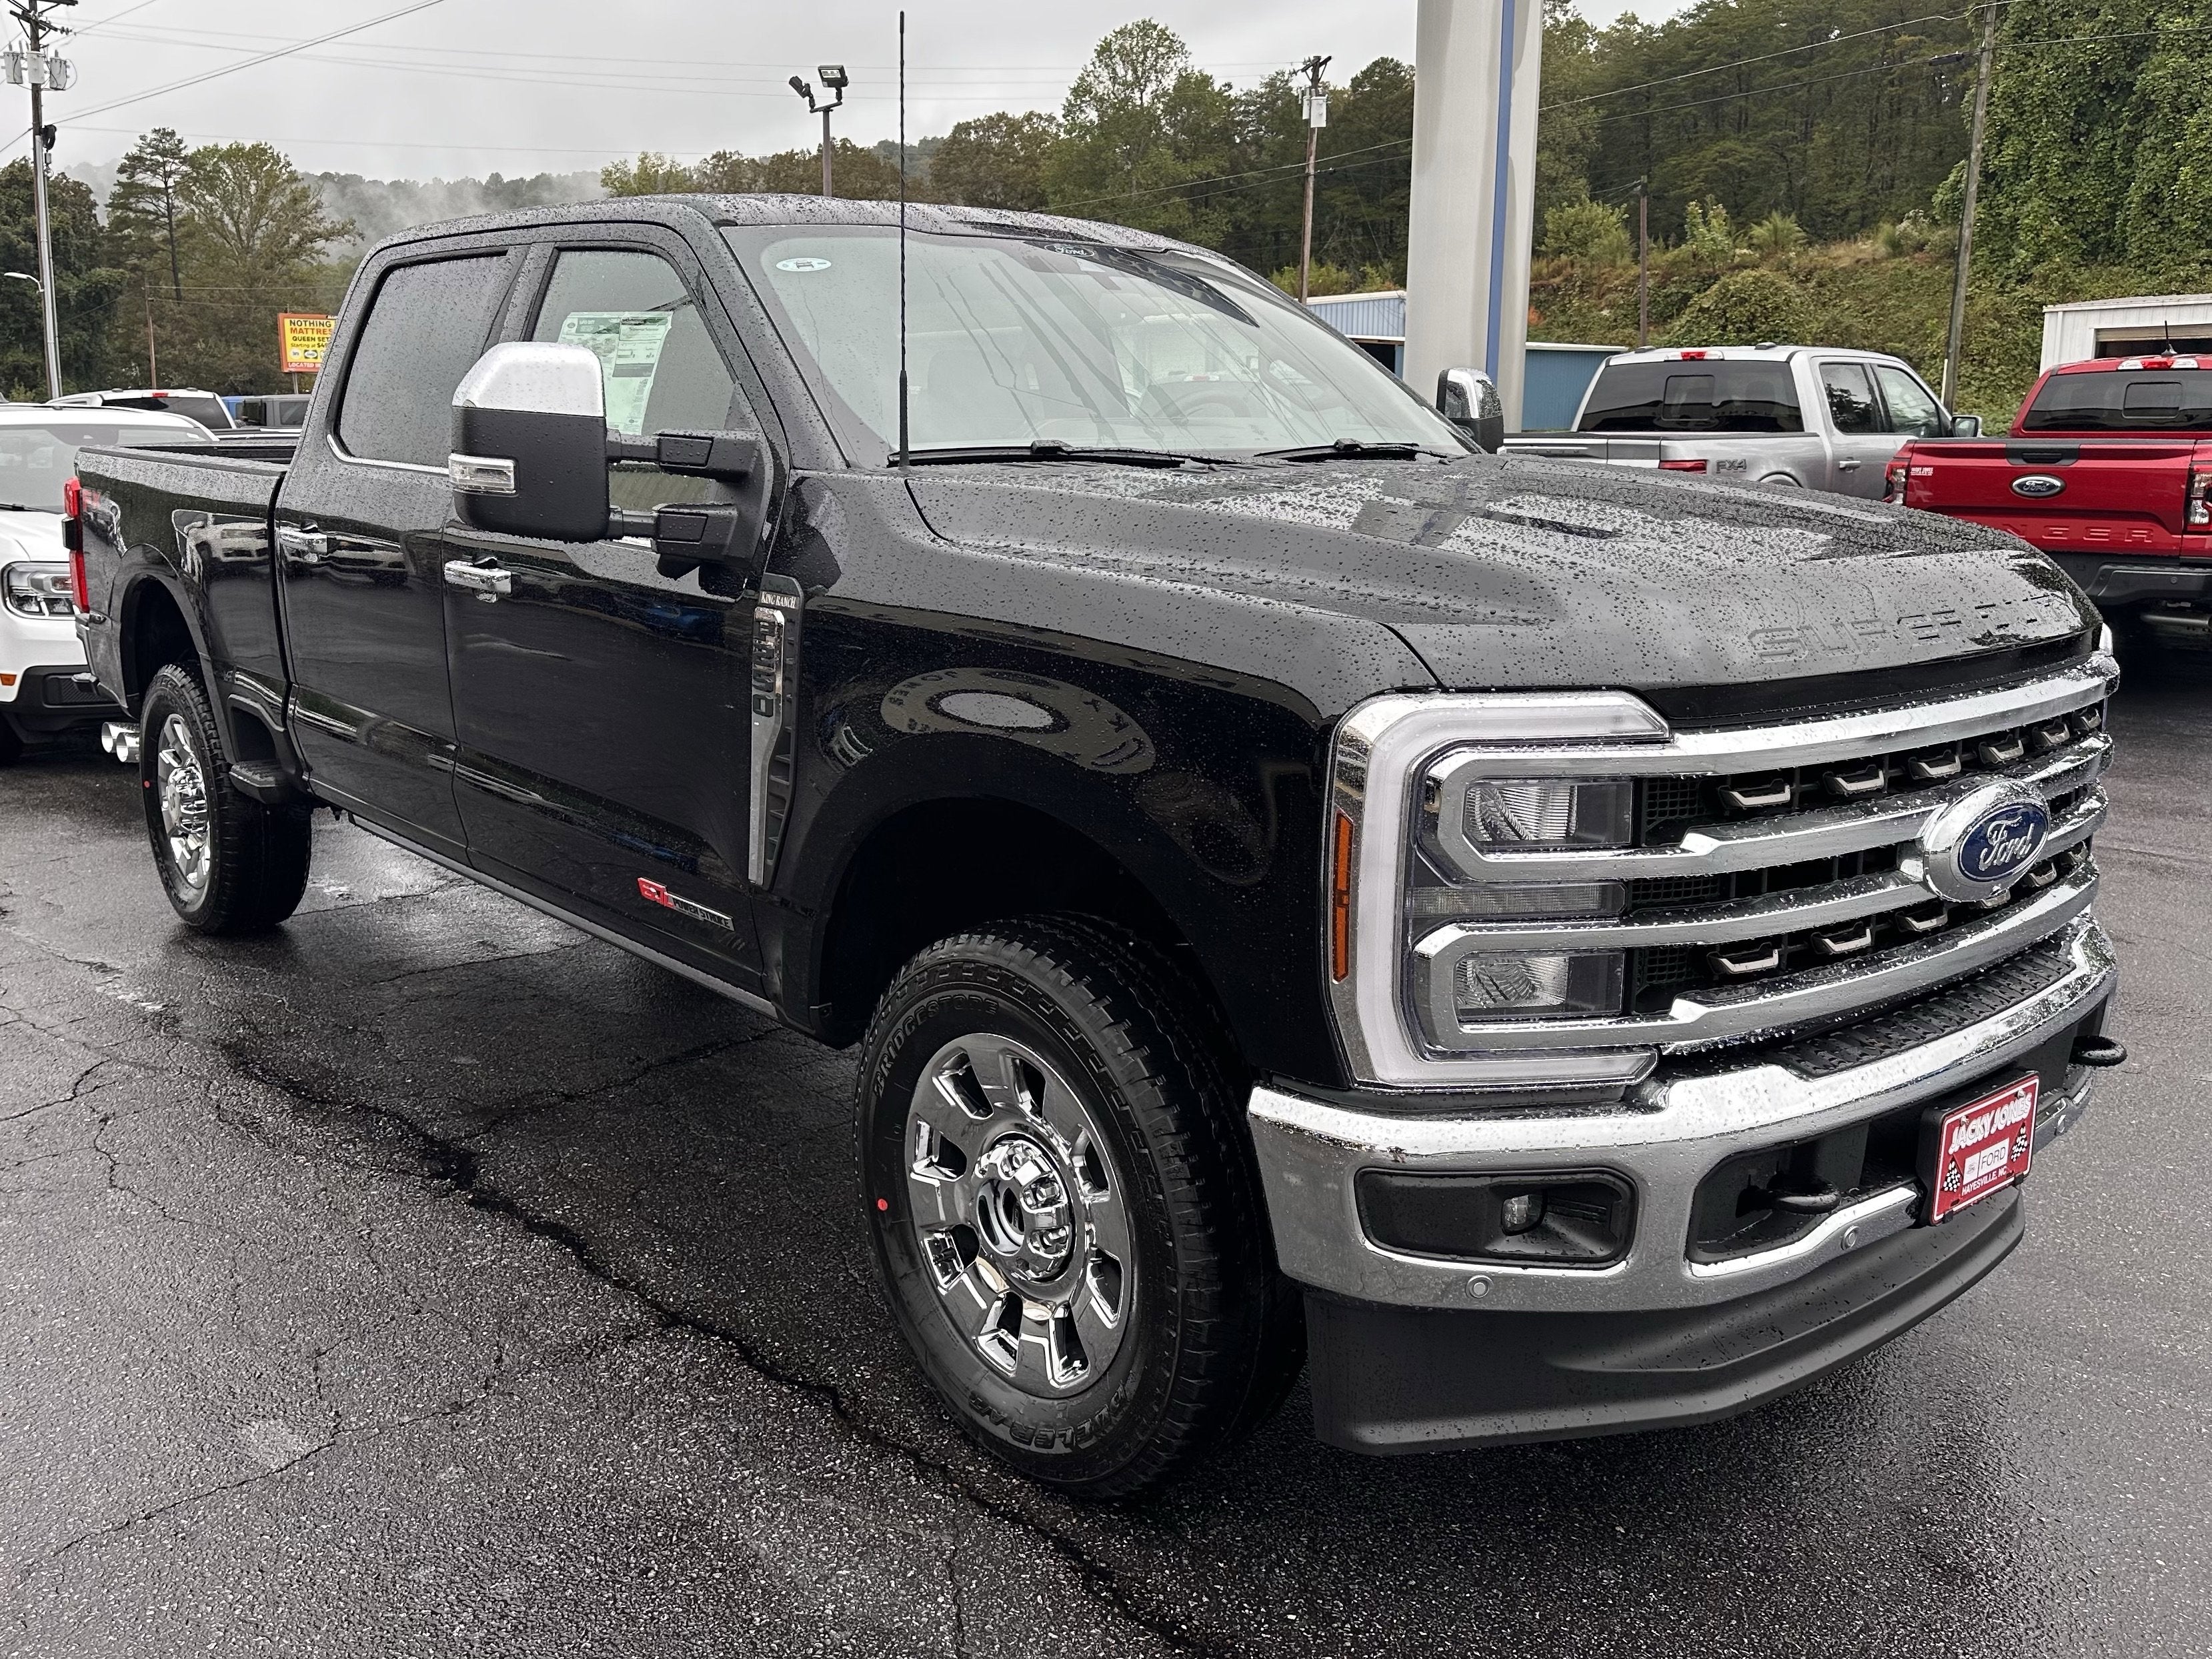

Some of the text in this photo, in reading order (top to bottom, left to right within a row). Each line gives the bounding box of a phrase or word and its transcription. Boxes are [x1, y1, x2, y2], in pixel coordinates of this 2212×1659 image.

[1716, 458, 1747, 474] FX4
[2023, 480, 2051, 491] Ford
[2001, 523, 2154, 544] NGER
[761, 591, 797, 609] KING RANCH
[1979, 815, 2034, 871] Ford
[1948, 1092, 2032, 1155] JACKY JONES
[1981, 1146, 2006, 1170] FORD
